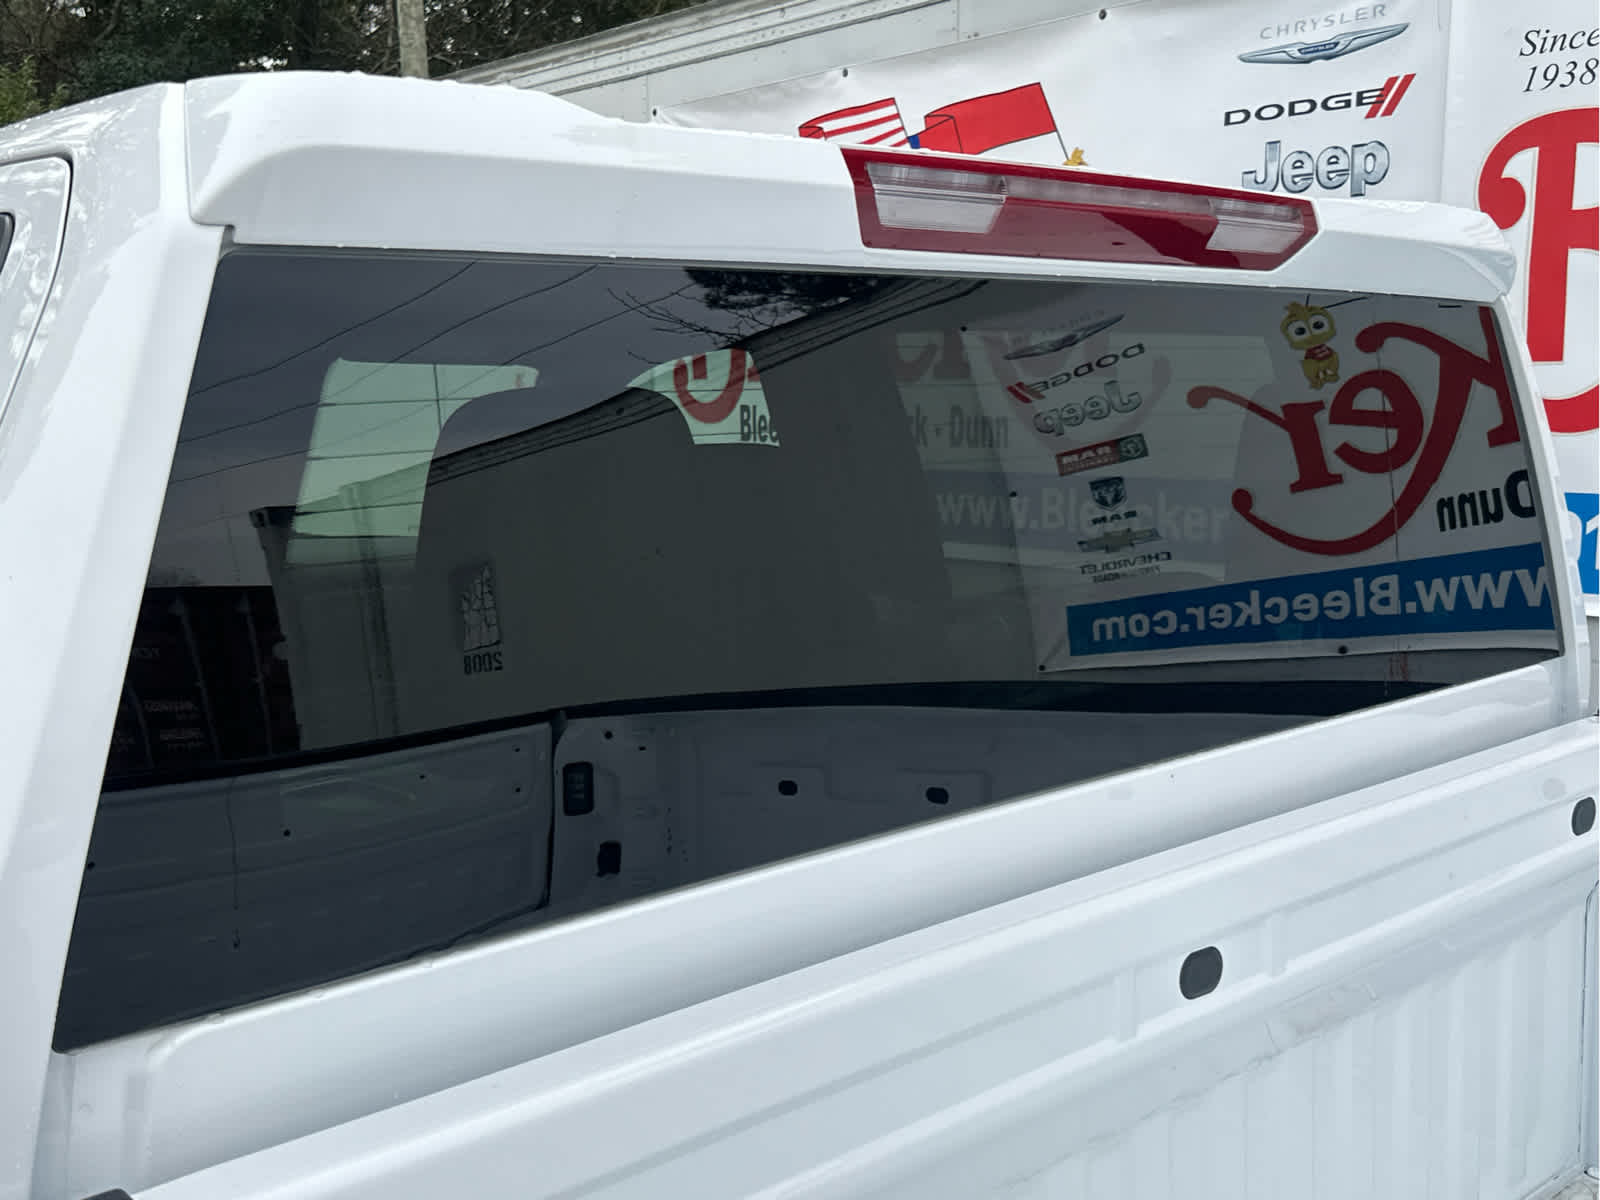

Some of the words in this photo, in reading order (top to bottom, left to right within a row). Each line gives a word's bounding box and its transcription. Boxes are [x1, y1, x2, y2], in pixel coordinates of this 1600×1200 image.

[1259, 3, 1388, 40] CHRYSLER
[1518, 26, 1600, 57] Since
[1521, 58, 1600, 94] 1938
[1223, 87, 1386, 126] DODGE
[1241, 139, 1391, 198] Jeep
